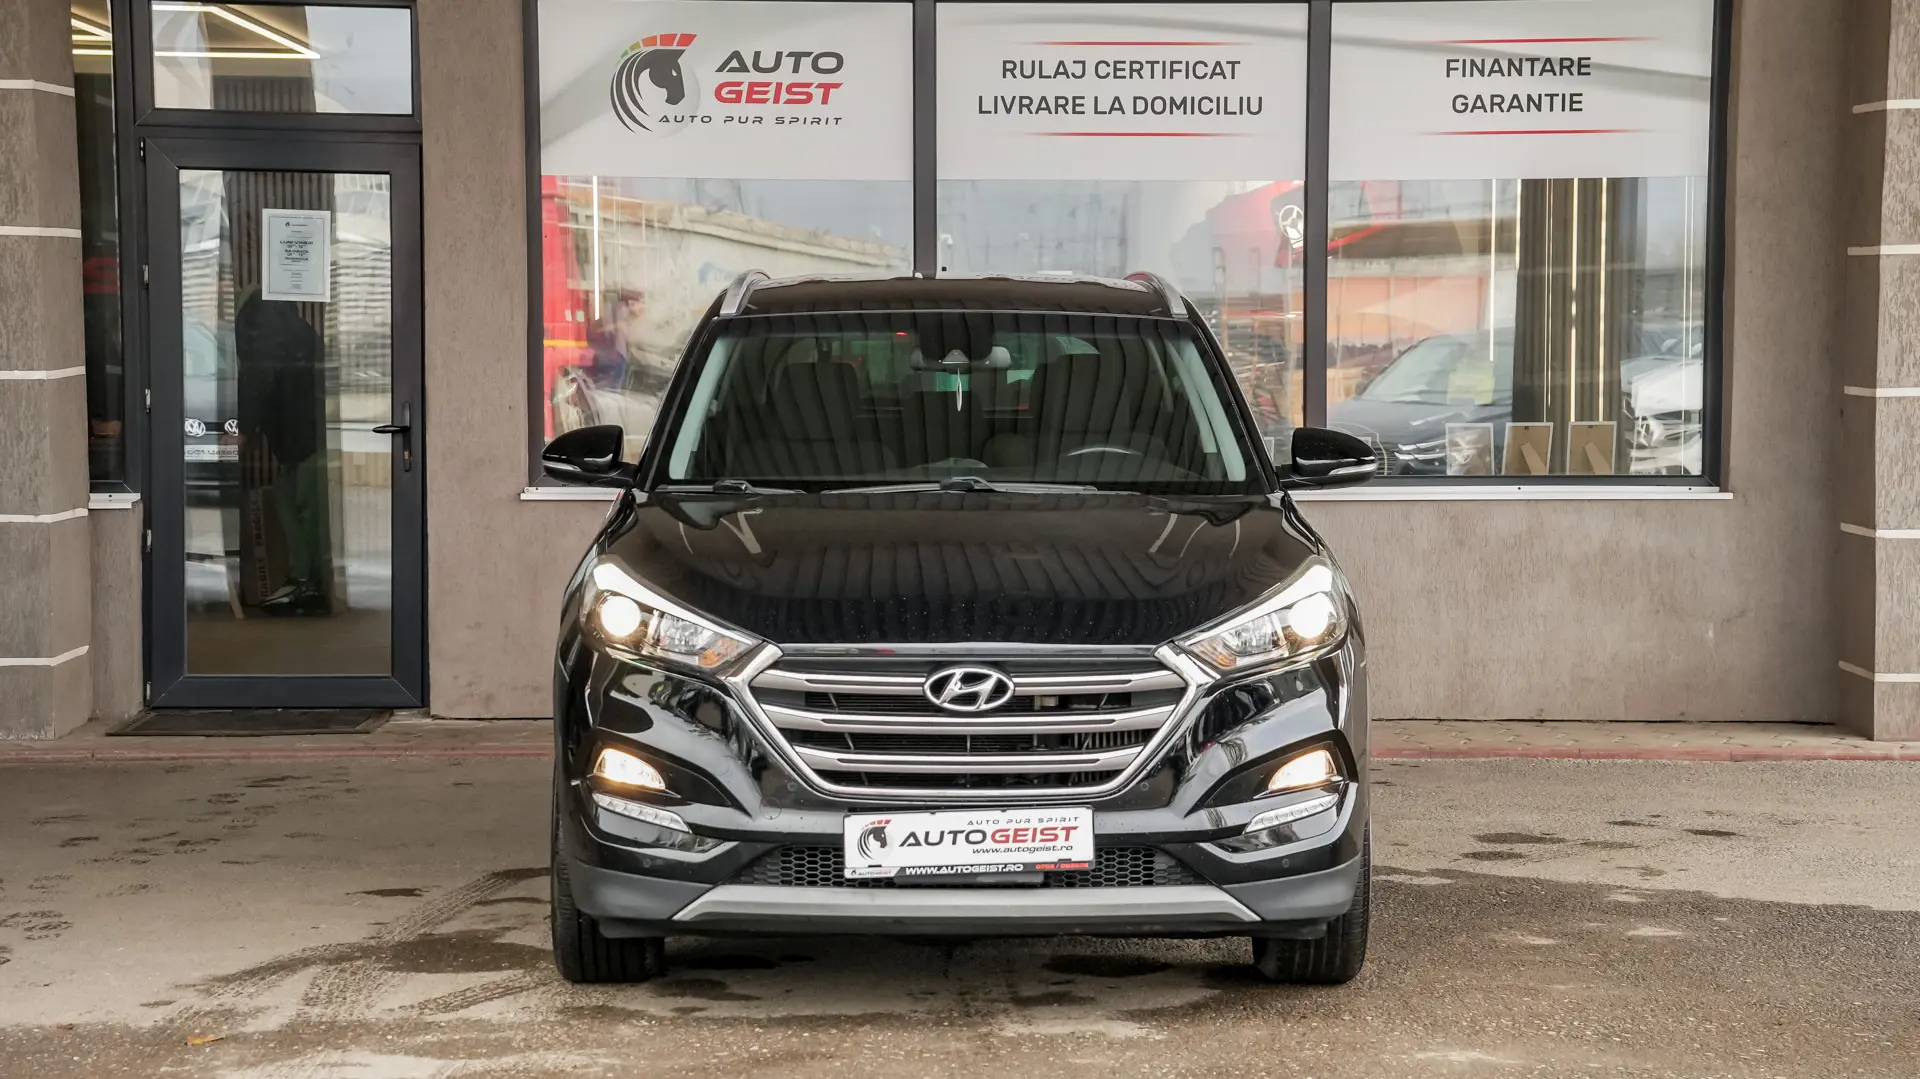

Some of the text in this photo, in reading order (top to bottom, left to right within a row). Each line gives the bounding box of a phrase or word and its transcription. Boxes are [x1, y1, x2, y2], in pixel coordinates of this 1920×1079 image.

[715, 50, 844, 74] AUTO
[1002, 60, 1241, 79] RULAJ CERTIFICAT
[1446, 57, 1592, 77] FINANTARE
[714, 81, 843, 105] GEIST
[978, 96, 1263, 116] LIVRARE LA DOMICILIU
[1452, 93, 1583, 113] GARANTIE
[659, 115, 843, 126] AUTO PUR SPIRIT
[1037, 816, 1080, 824] SPIRIT
[972, 844, 1074, 854] www.autogeist.ro
[905, 863, 1024, 876] WWW.AUTOGEIST.RO
